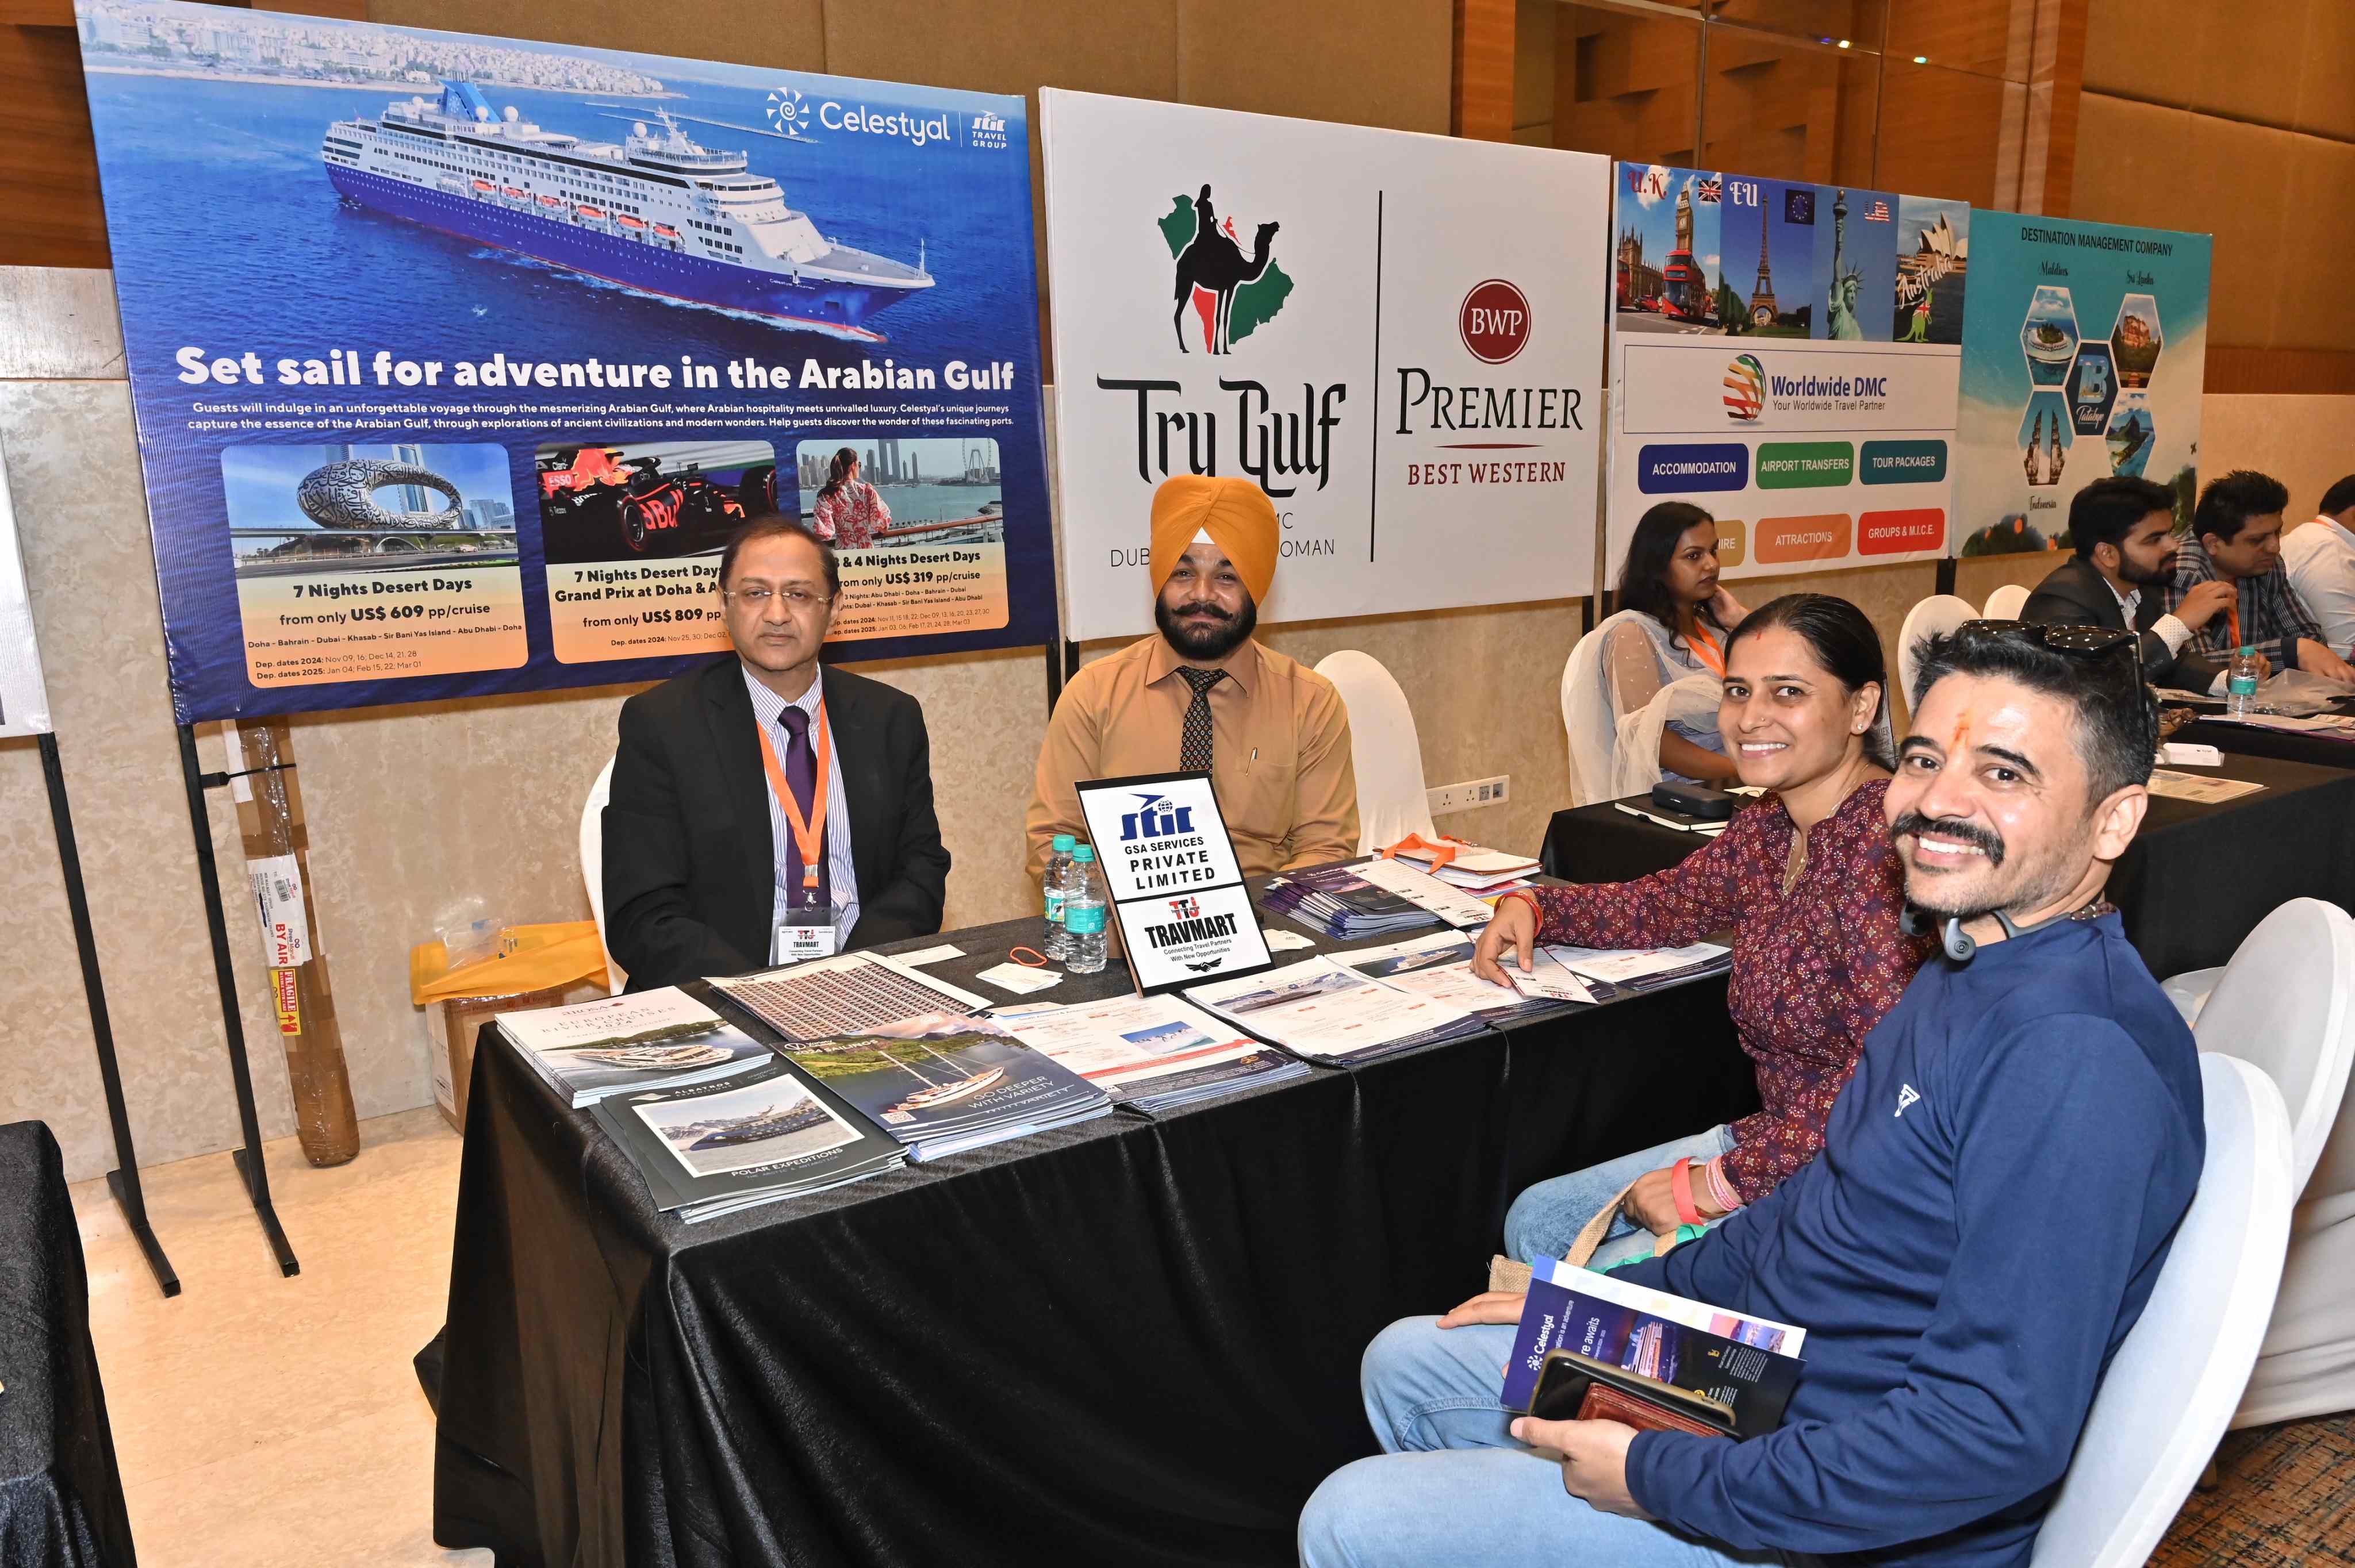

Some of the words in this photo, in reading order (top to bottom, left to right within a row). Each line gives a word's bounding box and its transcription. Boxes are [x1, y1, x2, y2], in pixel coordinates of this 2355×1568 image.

[819, 101, 950, 146] Celestyal
[972, 131, 1006, 140] TRAVEL
[973, 140, 1006, 149] GROUP
[1628, 171, 1667, 199] U.K.
[1729, 180, 1758, 207] EU
[2021, 226, 2076, 246] DESTINATION
[2078, 233, 2134, 253] MANAGEMENT
[2135, 240, 2172, 256] COMPANY
[2038, 260, 2069, 276] Maldives
[1897, 255, 1953, 309] Australia
[1471, 308, 1522, 336] BWP
[176, 347, 263, 385] Set
[277, 348, 360, 385] sail
[373, 351, 443, 386] for
[454, 353, 672, 388] adventure
[681, 355, 718, 388] in
[727, 358, 791, 389] the
[799, 358, 935, 389] Arabian
[944, 360, 1014, 390] Gulf
[1771, 375, 1850, 397] Worldwide
[1854, 376, 1886, 397] DMC
[193, 402, 239, 412] Guests
[240, 402, 262, 412] will
[265, 402, 312, 414] indulge
[314, 403, 325, 413] in
[346, 403, 427, 415] unforgettable
[429, 405, 470, 415] voyage
[472, 403, 516, 415] through
[519, 403, 538, 413] the
[539, 403, 607, 415] mesmerizing
[608, 403, 648, 413] Arabian
[650, 403, 673, 413] Gulf,
[675, 403, 705, 413] where
[707, 403, 744, 413] Arabian
[746, 404, 794, 414] hospitality
[825, 404, 868, 412] unrivalled
[870, 404, 898, 414] luxury.
[900, 403, 945, 414] Celestyal's
[946, 404, 974, 414] unique
[975, 404, 1009, 414] journeys
[1395, 367, 1583, 435] PREMIER
[1771, 399, 1790, 410] Your
[1793, 399, 1832, 410] Worldwide
[1835, 399, 1857, 410] Travel
[1859, 399, 1886, 410] Partner
[1096, 372, 1216, 484] Try
[1219, 375, 1347, 498] Gulf
[1652, 462, 1736, 475] ACCOMMODATION
[1761, 460, 1799, 472] AIRPORT
[1801, 458, 1849, 470] TRANSFERS
[1872, 457, 1893, 468] TOUR
[1895, 456, 1935, 467] PACKAGES
[549, 474, 572, 487] ESSO
[1407, 463, 1462, 485] BEST
[1468, 462, 1566, 483] WESTERN
[2028, 495, 2056, 510] Indonesia
[1775, 531, 1832, 545] ATTRACTIONS
[1868, 526, 1900, 539] GROUPS
[1901, 525, 1907, 536] &
[1909, 524, 1934, 536] M.I.C.E.
[842, 556, 852, 567] &
[854, 556, 863, 566] 4
[865, 554, 907, 568] Nights
[910, 552, 950, 563] Desert
[953, 551, 980, 563] Days
[1111, 548, 1150, 567] DUB
[1280, 539, 1335, 558] OMAN
[574, 571, 583, 583] 7
[587, 569, 637, 583] Nights
[640, 567, 688, 579] Desert
[840, 579, 859, 589] rom
[861, 576, 883, 587] only
[885, 574, 910, 585] US$
[912, 572, 933, 583] 319
[936, 571, 980, 583] pp/cruise
[293, 585, 303, 598] 7
[308, 583, 368, 598] Nights
[372, 580, 428, 594] Desert
[432, 578, 472, 592] Days
[279, 614, 313, 625] from
[317, 611, 346, 624] only
[351, 608, 386, 621] US$
[390, 606, 424, 619] 609
[428, 604, 490, 619] pp/cruise
[582, 617, 611, 627] from
[614, 614, 638, 627] only
[642, 612, 672, 623] US$
[675, 610, 703, 621] 809
[1125, 844, 1148, 855] GSA
[1150, 836, 1203, 851] SERVICES
[1130, 850, 1209, 872] PRIVATE
[1136, 867, 1214, 890] LIMITED
[1169, 896, 1199, 920] TTJ
[275, 924, 286, 940] BY
[1144, 913, 1237, 948] TRAVMART
[277, 943, 287, 965] AIR
[1163, 944, 1194, 955] Connecting
[1194, 941, 1210, 950] Travel
[1210, 938, 1232, 947] Partners
[1195, 947, 1230, 958] Opportunities
[284, 971, 296, 1012] FRAGILE
[542, 1021, 596, 1033] RIVER
[603, 1006, 676, 1024] CRUISES
[558, 1007, 650, 1026] EUROPEAN
[596, 1020, 632, 1029] 2024
[824, 1039, 879, 1052] SAILINGS
[674, 1081, 731, 1095] ALBATROS
[968, 1097, 1004, 1109] WITH
[1003, 1081, 1054, 1099] VARIETY
[973, 1092, 995, 1101] GO
[996, 1076, 1049, 1094] DEEPER
[731, 1166, 770, 1176] POLAR
[772, 1147, 843, 1170] EXPEDITIONS
[1534, 1314, 1555, 1354] Celestyal
[1584, 1316, 1600, 1344] awaits
